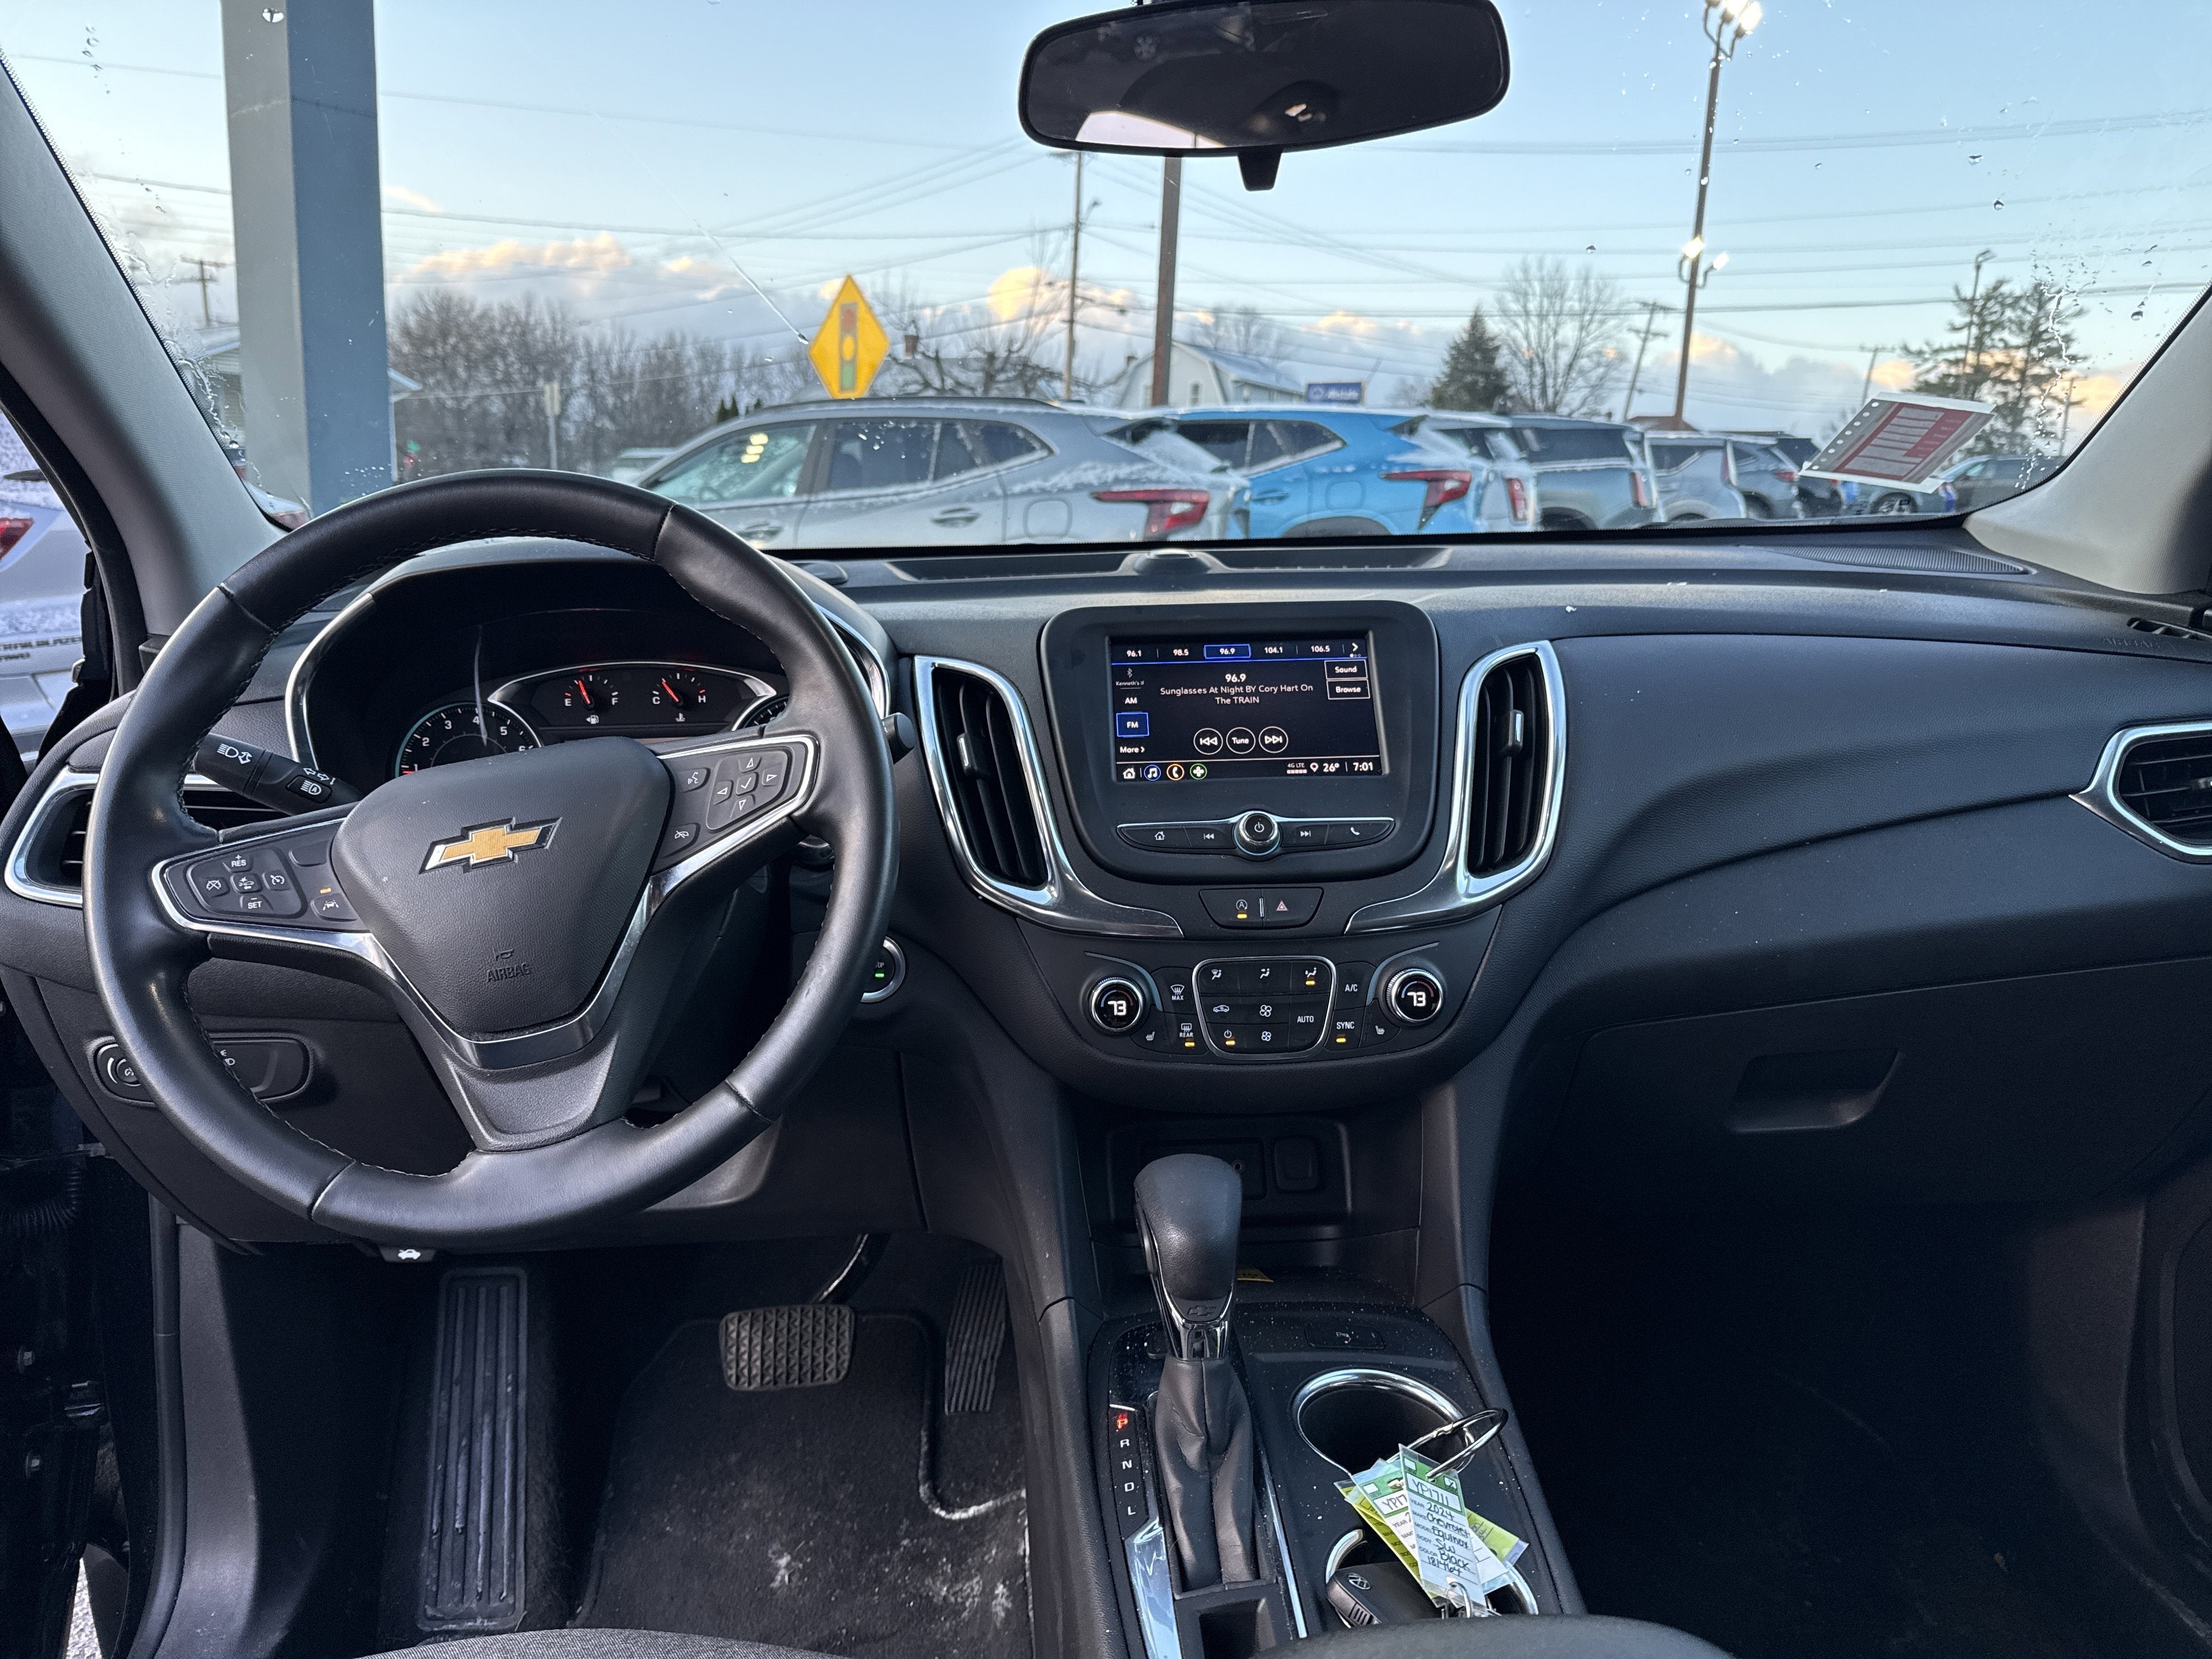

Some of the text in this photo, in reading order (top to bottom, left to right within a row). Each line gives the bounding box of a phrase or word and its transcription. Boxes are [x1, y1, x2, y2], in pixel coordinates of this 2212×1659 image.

[1224, 673, 1246, 682] 96.9
[1160, 686, 1207, 696] Sunglasses
[1220, 685, 1244, 695] Night
[1259, 685, 1278, 693] Cory
[565, 698, 572, 707] E
[612, 697, 618, 706] F
[652, 696, 661, 704] C
[698, 695, 706, 703] H
[444, 720, 452, 730] 3
[500, 726, 507, 736] 5
[422, 737, 430, 747] 2
[1352, 761, 1373, 771] 7:01
[231, 859, 246, 867] RES
[247, 901, 262, 909] SET
[486, 962, 532, 983] AIRBAG
[1345, 984, 1358, 992] A/C
[1407, 991, 1426, 1007] 73
[1108, 1000, 1126, 1016] 73
[1297, 1015, 1314, 1024] AUTO
[1336, 1021, 1355, 1030] SYNC
[1116, 1417, 1129, 1429] P
[1120, 1438, 1130, 1448] R
[1122, 1459, 1132, 1470] N
[1124, 1482, 1135, 1492] D
[1127, 1506, 1136, 1515] L
[1426, 1502, 1455, 1521] 2024
[1438, 1548, 1470, 1571] Black
